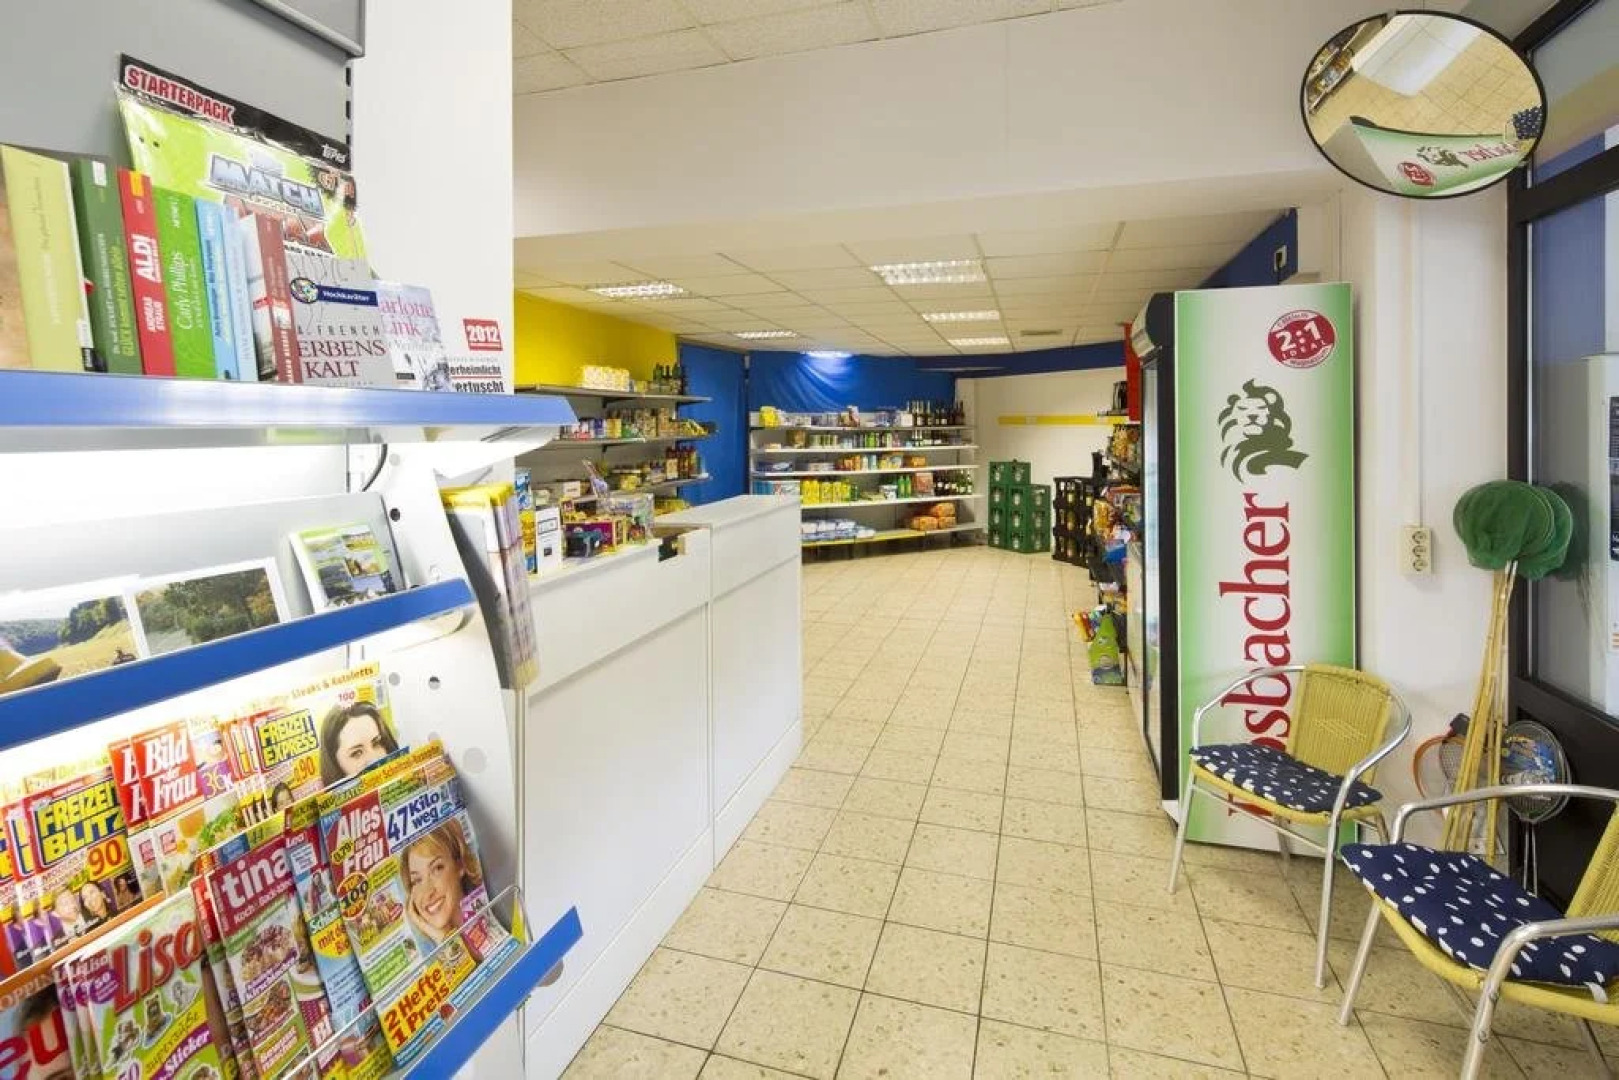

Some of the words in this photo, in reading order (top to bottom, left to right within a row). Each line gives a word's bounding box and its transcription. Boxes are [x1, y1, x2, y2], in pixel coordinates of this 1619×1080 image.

[126, 66, 234, 126] STARTERPACK
[211, 155, 324, 218] MATCH
[131, 233, 157, 282] ALDI
[169, 252, 189, 296] Phillips
[175, 297, 192, 330] Carly
[322, 290, 371, 302] Hochkaräter
[317, 325, 380, 338] FRENCH
[466, 325, 501, 344] 2012
[1275, 320, 1321, 352] 2:1
[303, 359, 360, 379] KALT
[260, 712, 316, 746] FREIZEIT
[144, 729, 189, 778] Bild
[262, 734, 318, 768] EXPRESS
[151, 770, 198, 815] Frau
[337, 803, 382, 838] Alles
[387, 806, 411, 843] 47
[410, 791, 440, 817] Kilo
[411, 806, 439, 830] weg
[87, 840, 123, 877] 90
[343, 838, 385, 876] Frau
[221, 847, 291, 909] tina
[112, 920, 203, 1017] Lisa
[384, 1009, 398, 1033] 2
[399, 967, 443, 1016] Hefte
[391, 1030, 409, 1047] 1
[405, 984, 450, 1034] Preis
